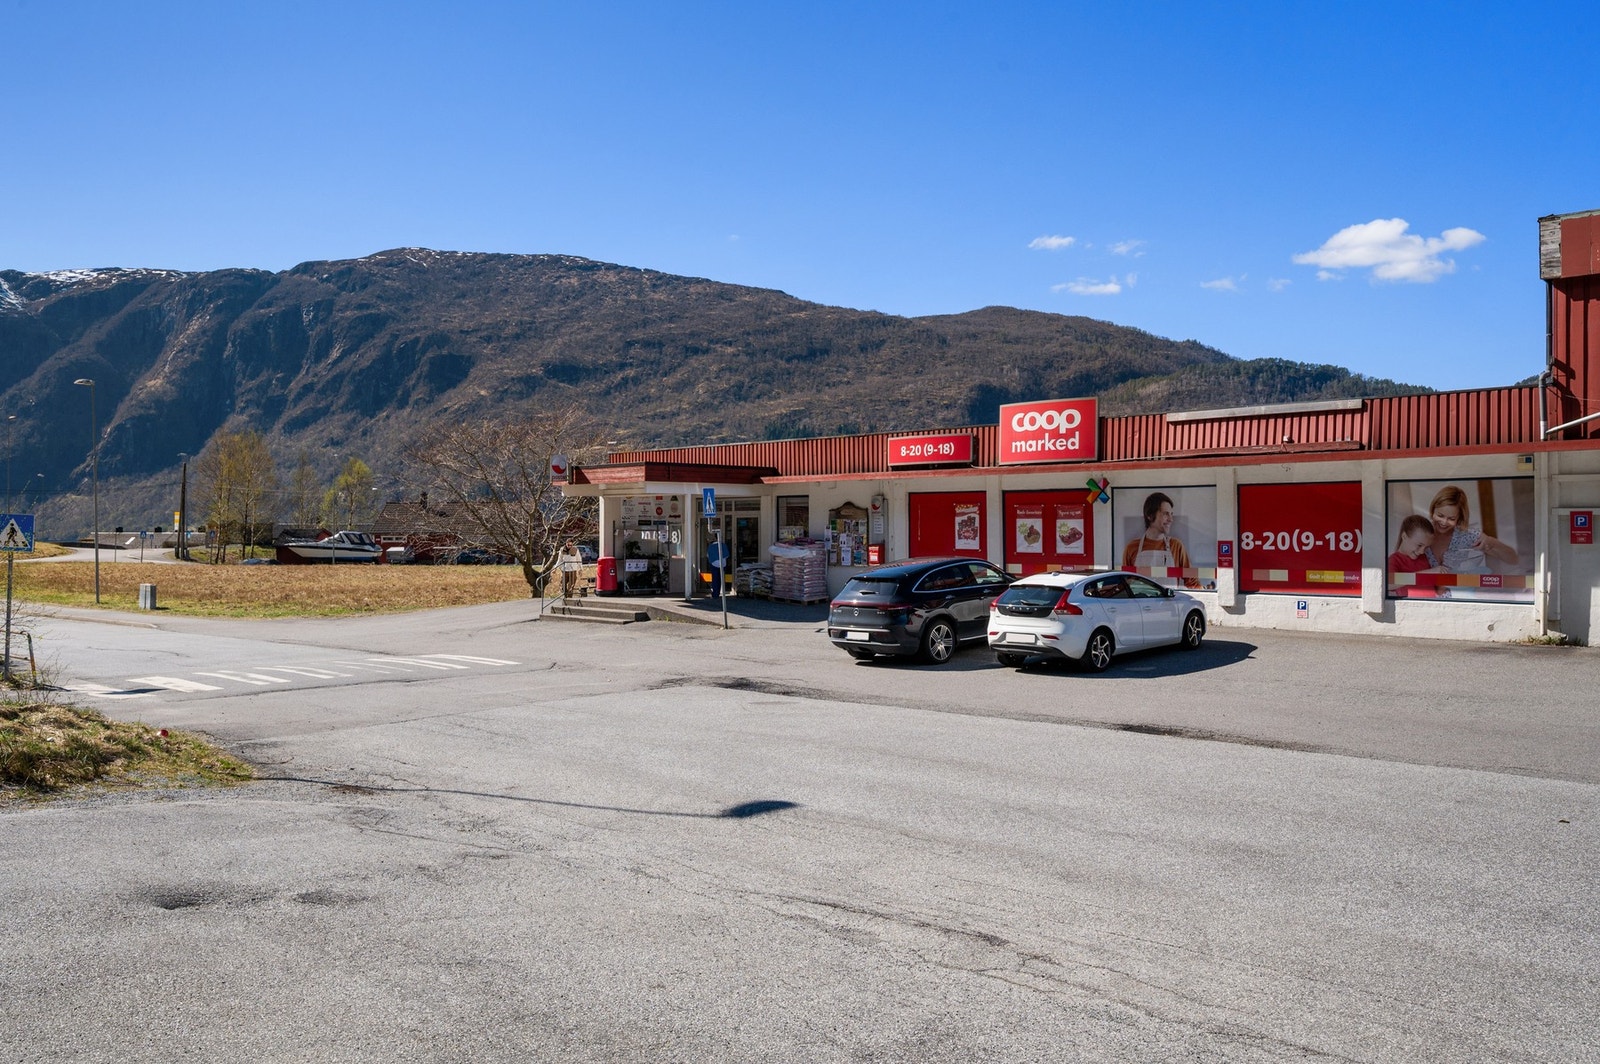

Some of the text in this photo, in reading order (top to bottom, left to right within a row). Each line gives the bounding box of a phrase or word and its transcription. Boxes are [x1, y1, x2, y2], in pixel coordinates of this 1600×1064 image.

[1011, 408, 1082, 434] coop
[900, 442, 955, 457] 8-20 (9-18)
[1011, 431, 1080, 453] marked
[1577, 517, 1585, 526] P
[1222, 545, 1228, 553] P
[1240, 528, 1363, 553] 8-20(9-18)
